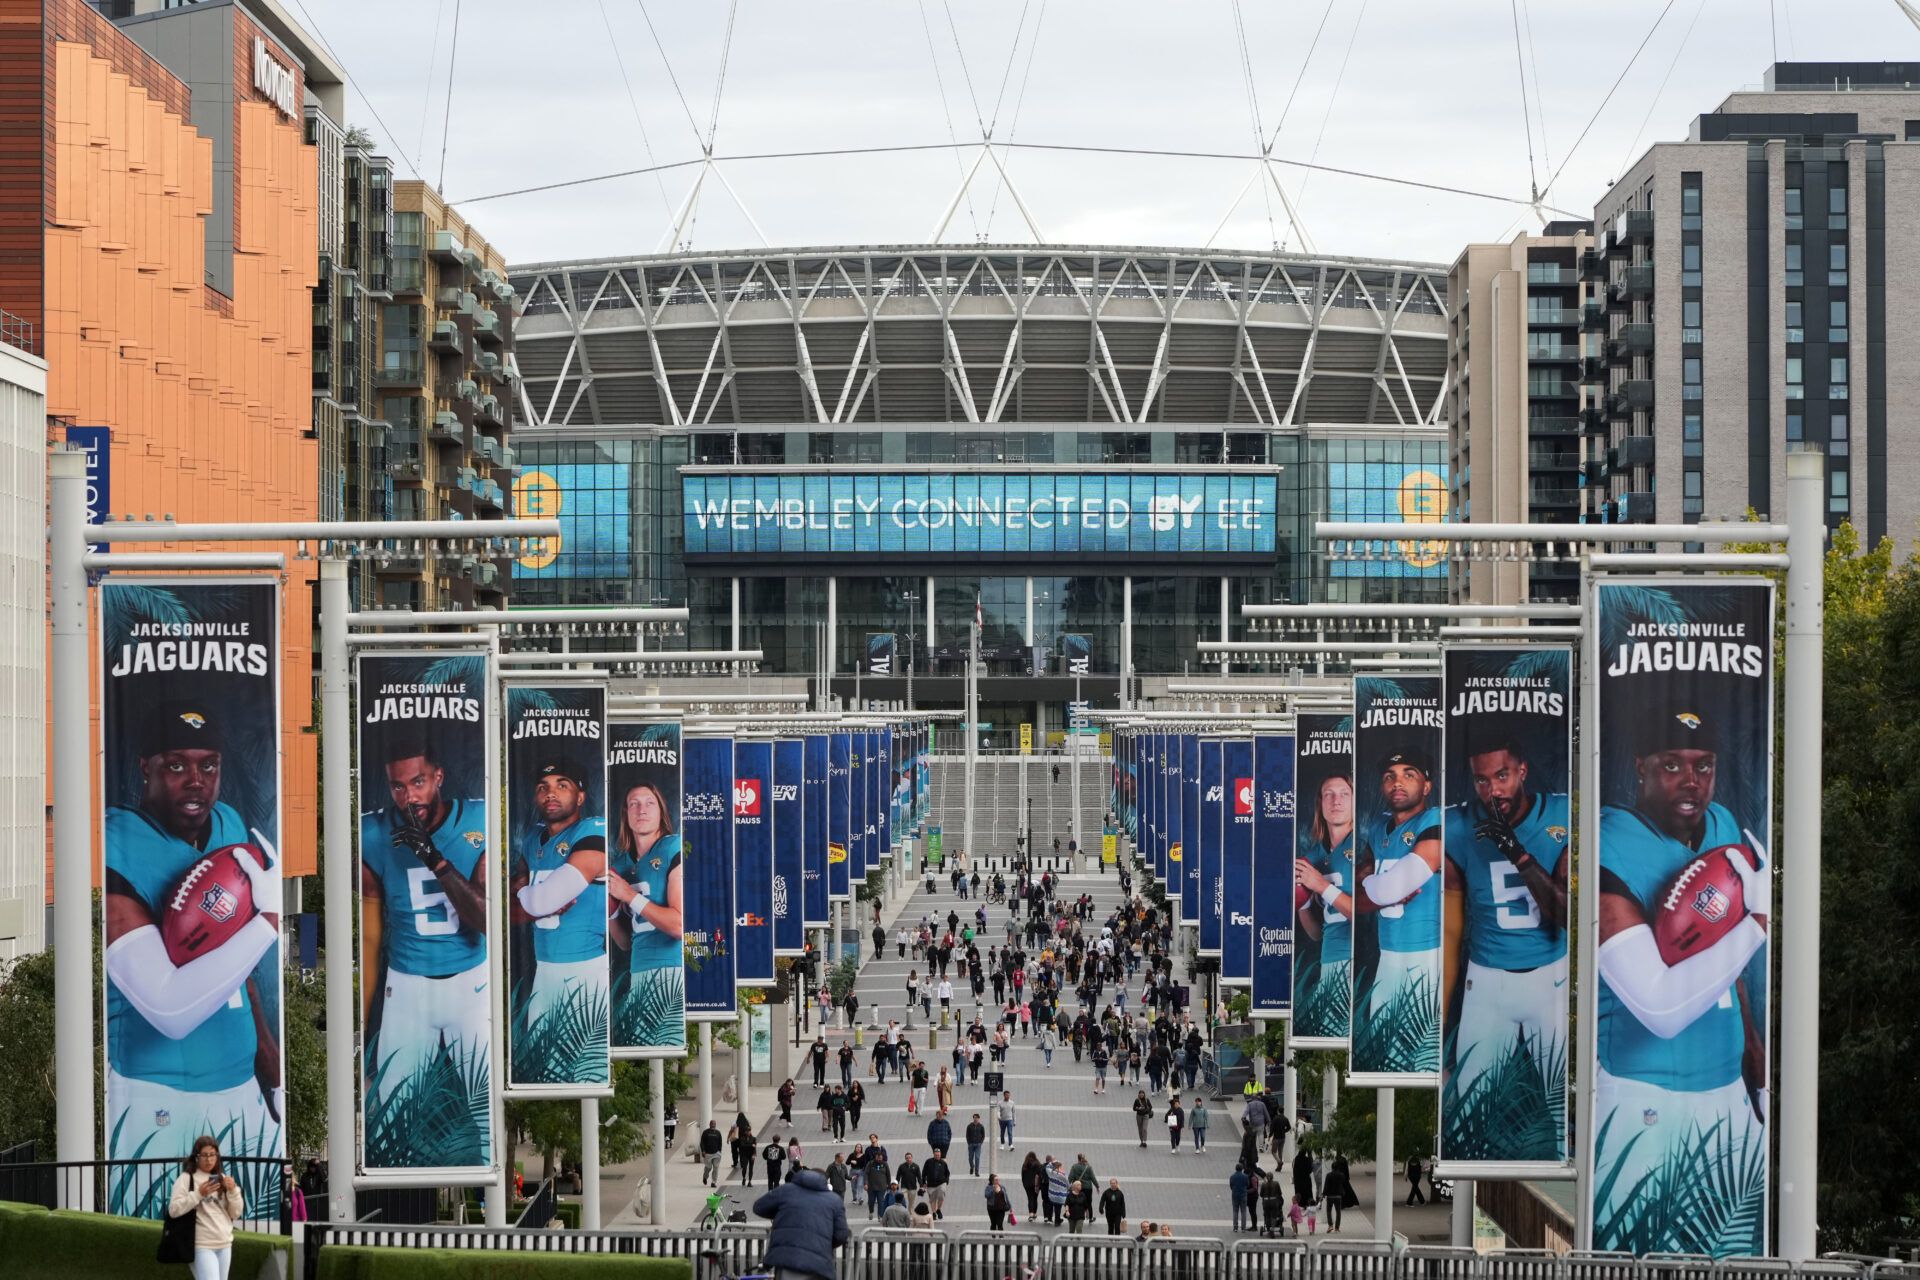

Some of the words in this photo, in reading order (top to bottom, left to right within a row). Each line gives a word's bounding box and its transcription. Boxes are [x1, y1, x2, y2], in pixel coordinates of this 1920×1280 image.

[694, 495, 883, 530] WEMBLEY
[891, 494, 1132, 529] CONNECTED
[1148, 494, 1203, 531] BY
[1218, 499, 1264, 529] EE
[131, 622, 249, 637] JACKSONVILLE
[1626, 622, 1745, 637] JACKSONVILLE
[112, 641, 267, 677] JAGUARS
[1608, 642, 1762, 677] JAGUARS
[380, 683, 466, 694] JACKSONVILLE
[1465, 677, 1550, 688] JACKSONVILLE
[366, 696, 480, 723] JAGUARS
[1371, 698, 1438, 707] JACKSONVILLE
[1451, 691, 1563, 717] JAGUARS
[522, 708, 590, 717] JACKSONVILLE
[1360, 708, 1443, 728] JAGUARS
[512, 719, 600, 740] JAGUARS
[1309, 731, 1352, 739] JACKSONVI
[614, 740, 669, 748] JACKSONVILLE
[1300, 740, 1352, 756] JAGUA
[606, 749, 677, 766] JAGUARS
[773, 791, 796, 801] EN
[1235, 816, 1254, 824] STRA
[406, 869, 461, 936] 5
[1490, 861, 1541, 929] 5
